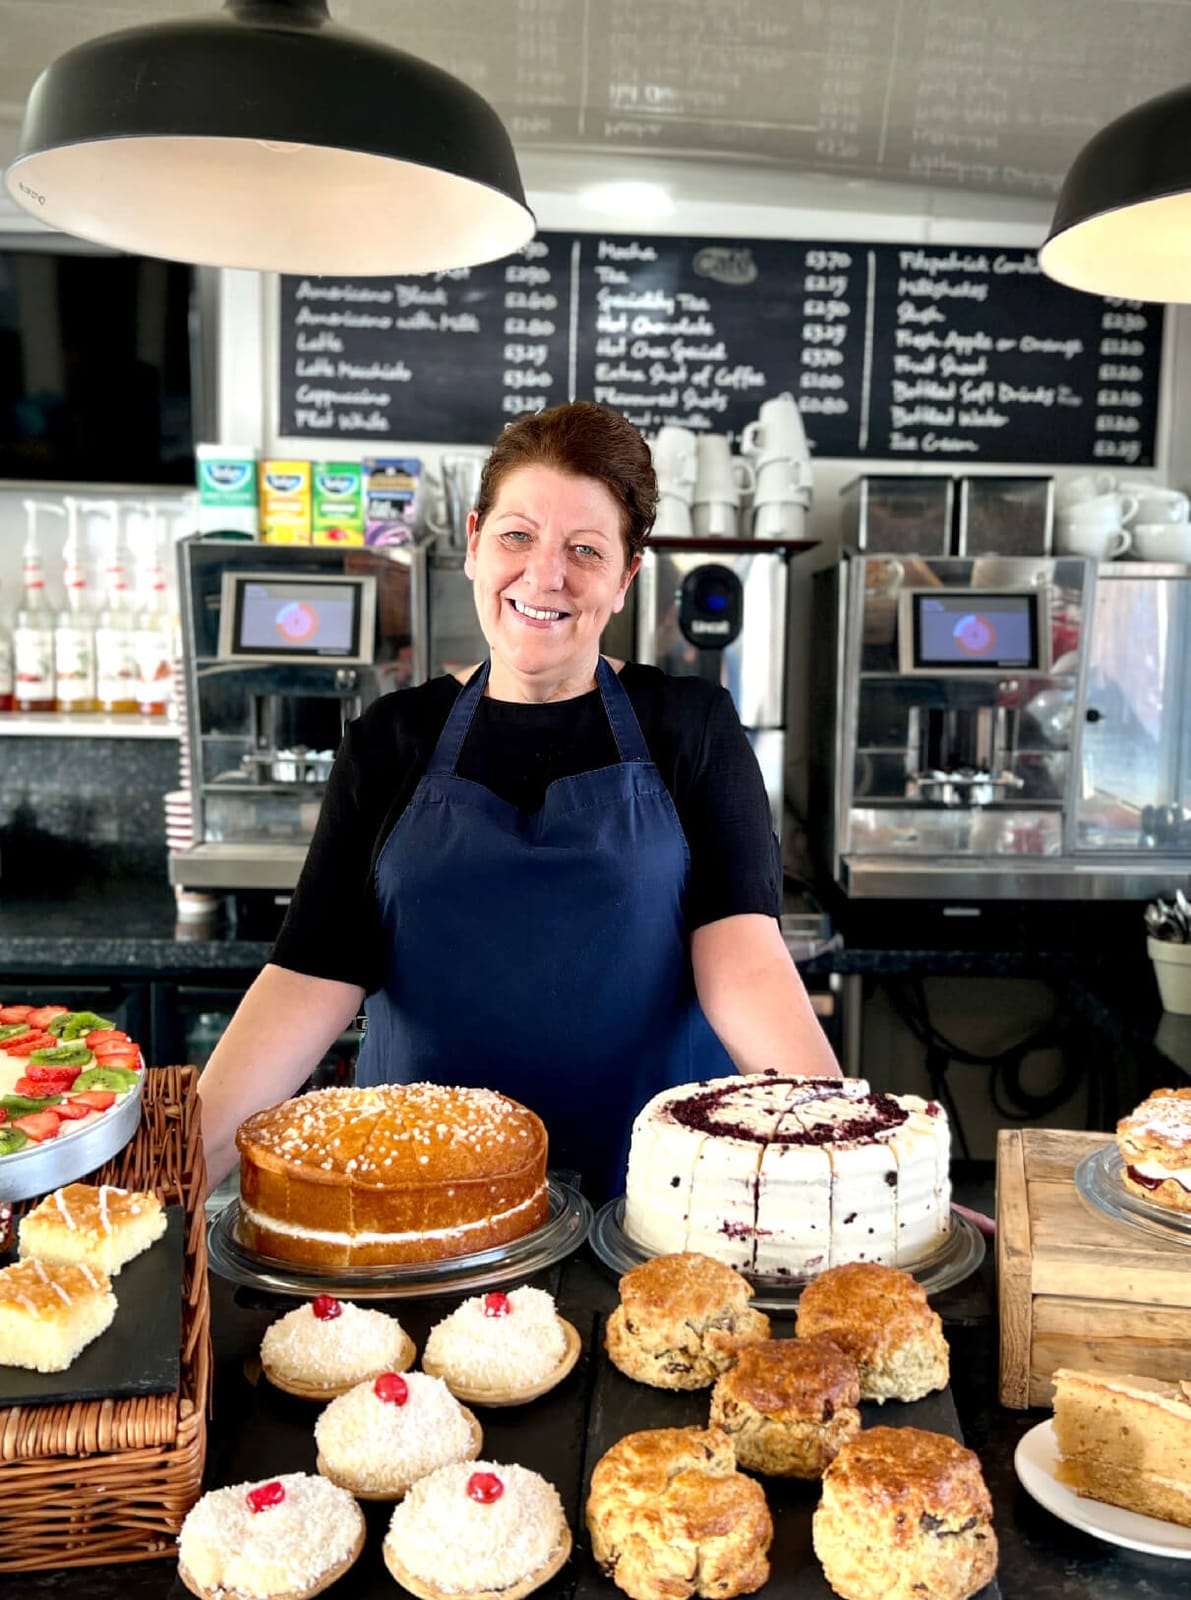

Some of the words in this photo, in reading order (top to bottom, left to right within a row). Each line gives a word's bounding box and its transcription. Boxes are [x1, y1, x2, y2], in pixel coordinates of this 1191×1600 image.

[598, 240, 658, 260] Mocha
[594, 265, 629, 284] Tea
[295, 280, 393, 304] Americano
[395, 283, 448, 307] Black
[675, 292, 710, 311] Tea
[295, 306, 393, 330] Americano
[596, 312, 627, 333] Hot
[631, 314, 715, 336] Chocolate
[296, 331, 344, 352] Latte
[596, 337, 627, 358] Hot
[943, 330, 993, 356] Apple
[295, 357, 336, 378] Latte
[594, 362, 647, 382] Extra
[691, 364, 714, 388] of
[714, 366, 767, 390] Coffee
[891, 379, 957, 403] Bottled
[890, 405, 955, 429] Bottled
[889, 431, 918, 450] Ice
[920, 431, 980, 452] Cream
